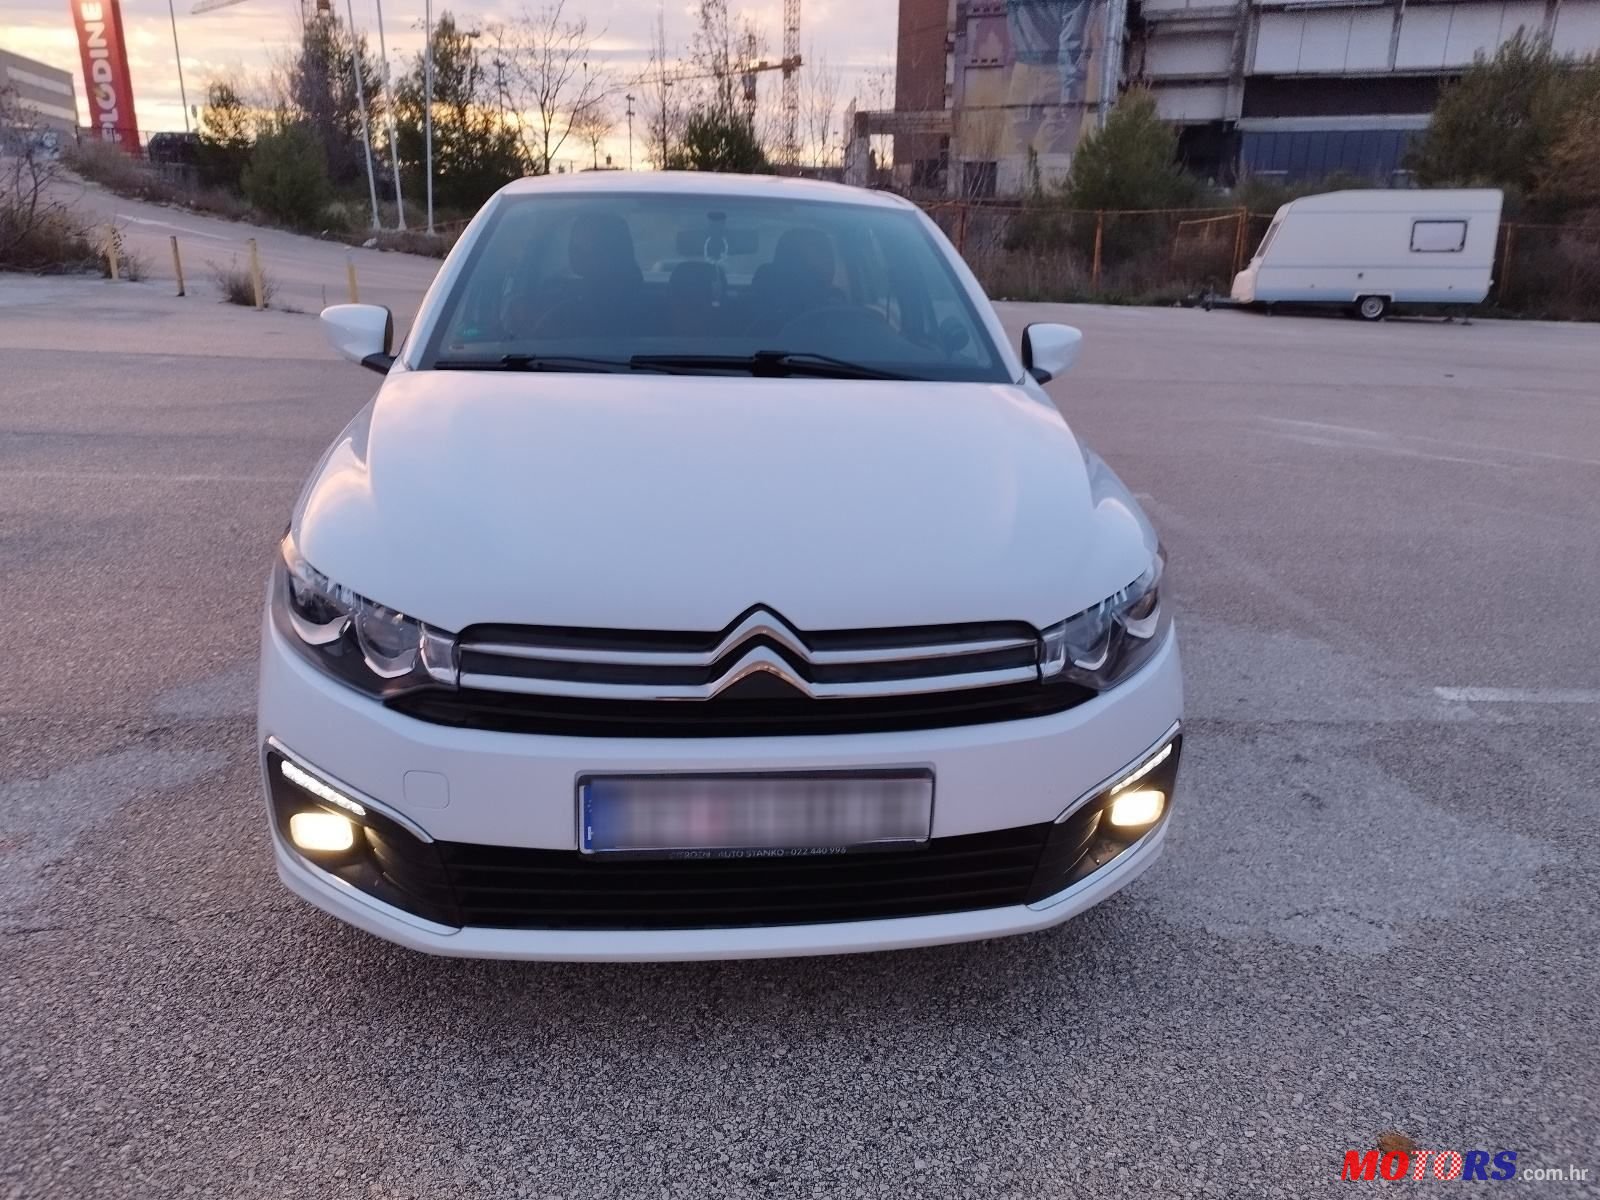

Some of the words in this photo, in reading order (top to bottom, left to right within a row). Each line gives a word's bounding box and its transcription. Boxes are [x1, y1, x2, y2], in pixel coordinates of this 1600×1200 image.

[745, 848, 785, 858] STANKO
[790, 847, 808, 856] 022
[810, 846, 828, 855] 440
